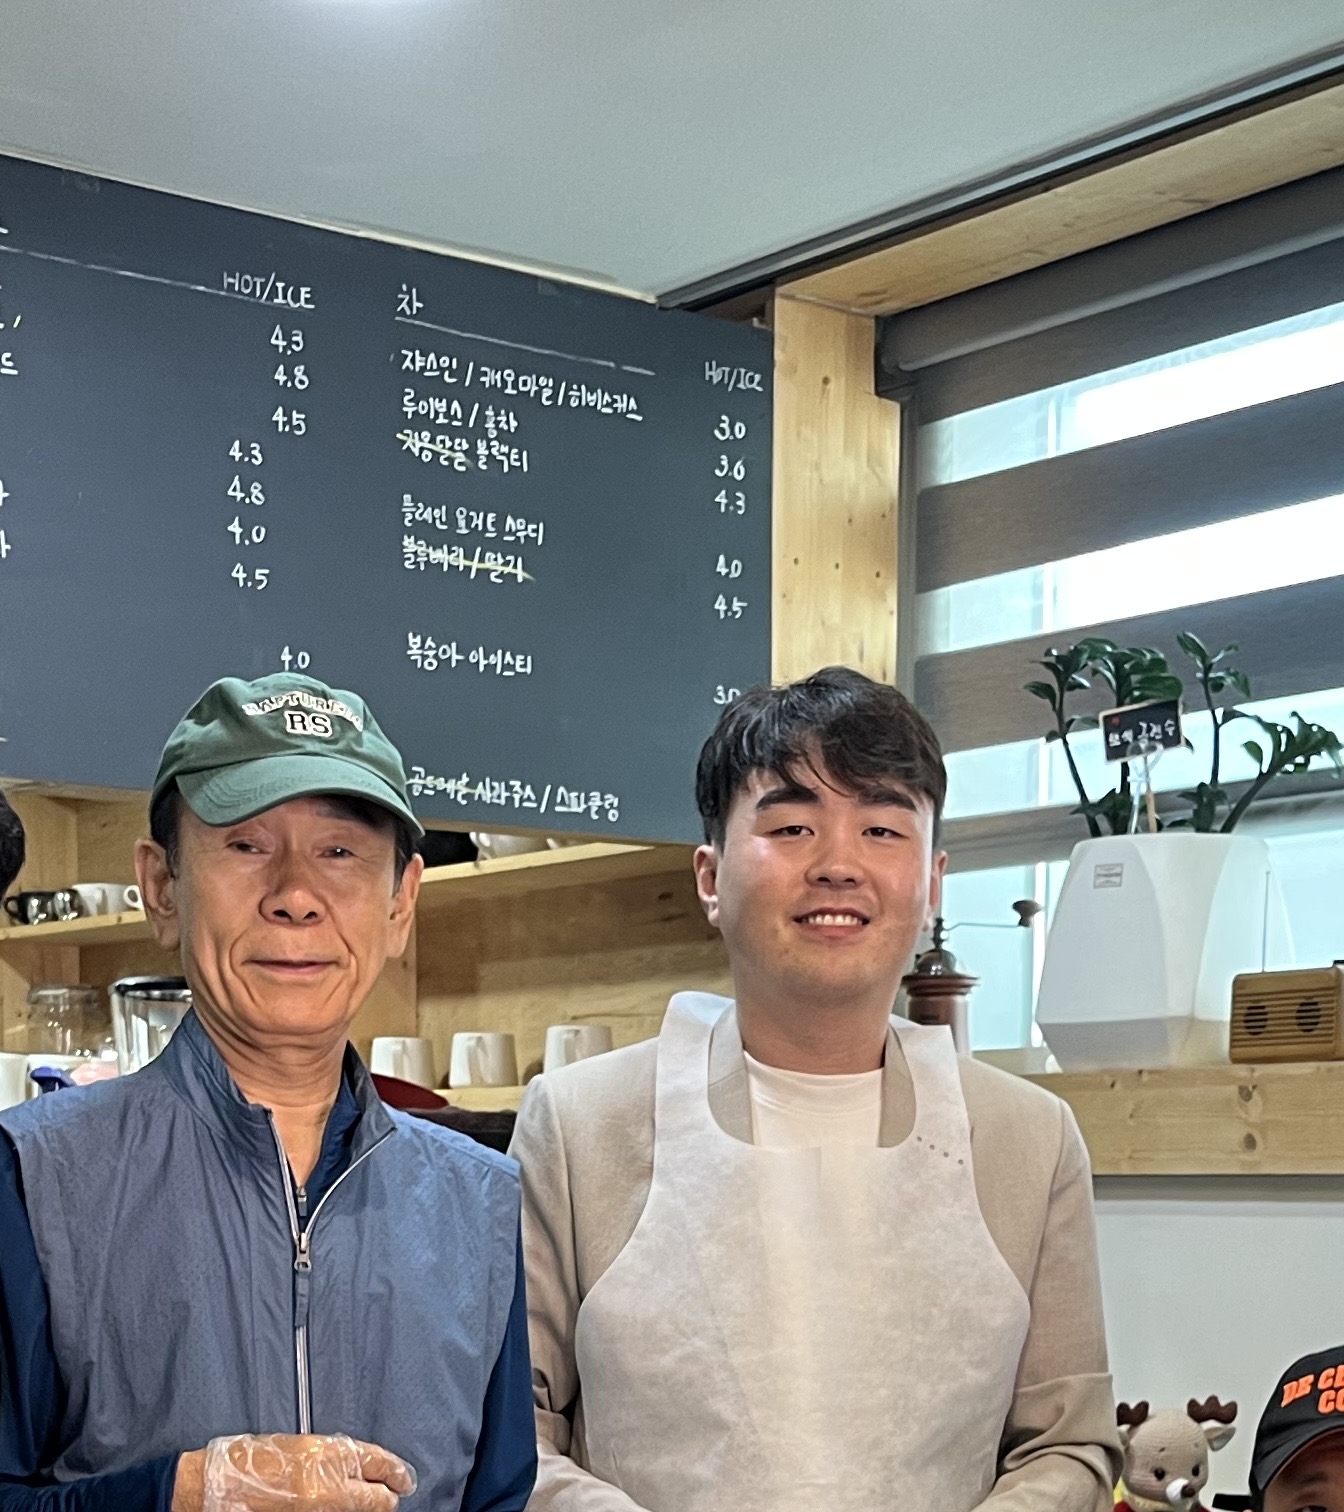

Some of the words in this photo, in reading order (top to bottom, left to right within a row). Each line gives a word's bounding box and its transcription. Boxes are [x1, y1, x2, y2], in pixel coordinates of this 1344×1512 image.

[396, 283, 424, 316] 차
[270, 324, 304, 356] 4.3
[273, 364, 311, 391] 4.8
[271, 405, 307, 436] 4.5
[402, 387, 463, 427] 루이보스
[484, 405, 519, 439] 홍차
[714, 414, 746, 441] 3.0
[228, 440, 264, 466] 4.3
[476, 438, 529, 473] 블랙티
[227, 475, 266, 506] 4.8
[714, 489, 746, 515] 4.3
[227, 516, 266, 546] 4.0
[502, 513, 544, 546] 스무디
[230, 562, 270, 590] 4.5
[714, 592, 748, 620] 4.5
[280, 645, 311, 672] 4.0
[406, 631, 465, 671] 복숭아
[468, 645, 533, 676] 아이스티
[287, 712, 331, 735] RS
[1280, 1374, 1315, 1408] DE
